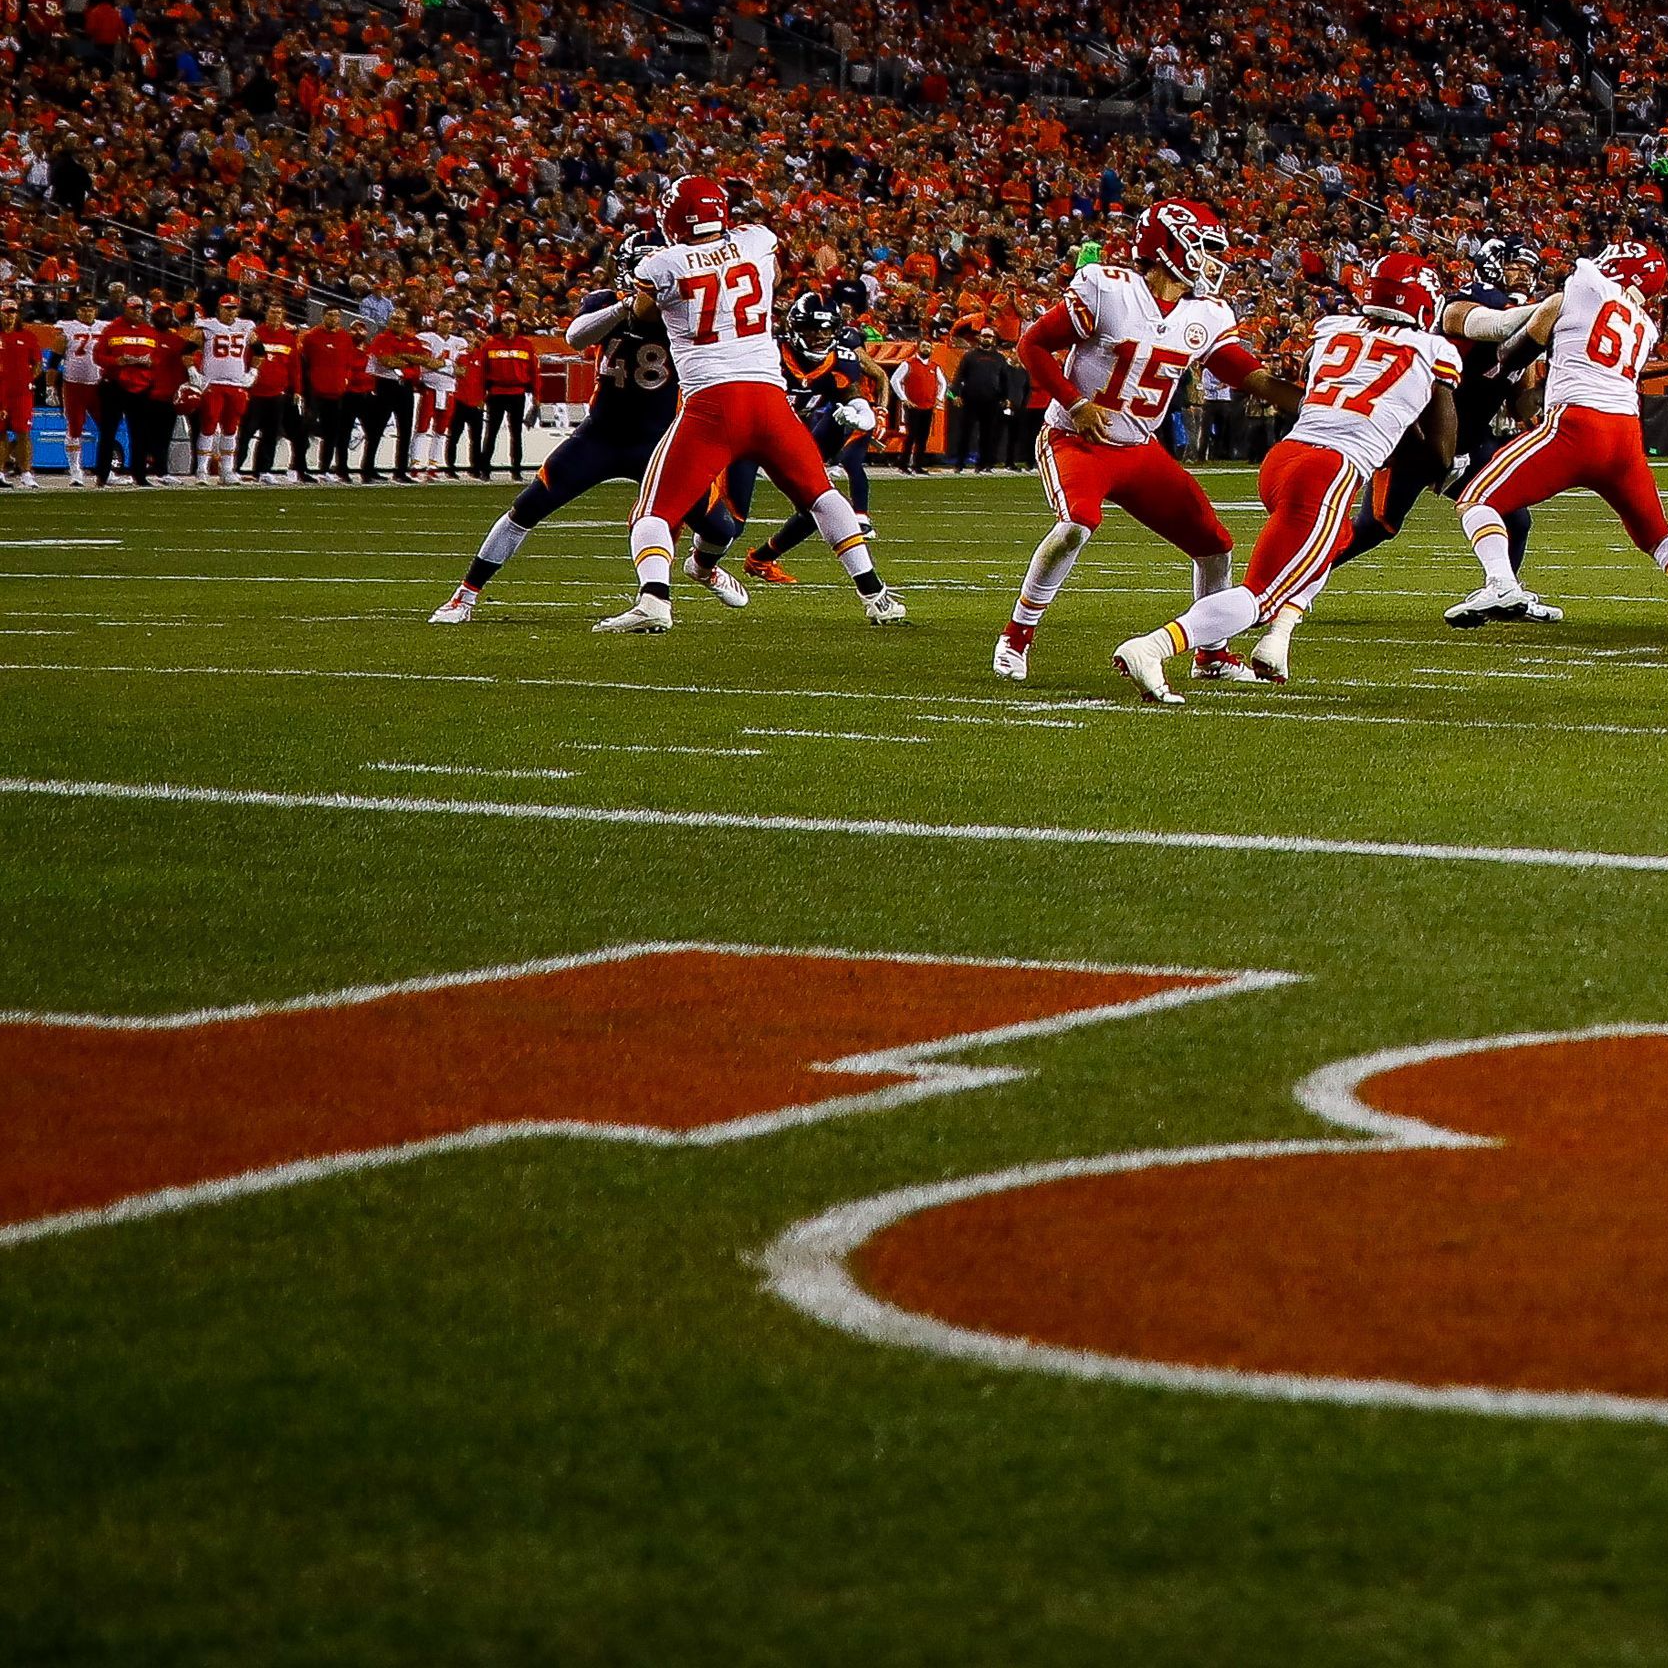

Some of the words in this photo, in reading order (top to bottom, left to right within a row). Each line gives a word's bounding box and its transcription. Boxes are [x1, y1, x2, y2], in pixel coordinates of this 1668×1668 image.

[687, 242, 741, 270] FISHER
[676, 262, 767, 346] 72
[1586, 299, 1646, 381] 61
[212, 334, 244, 358] 65
[599, 337, 670, 390] 48
[1094, 337, 1192, 419] 15
[1304, 332, 1418, 417] 27
